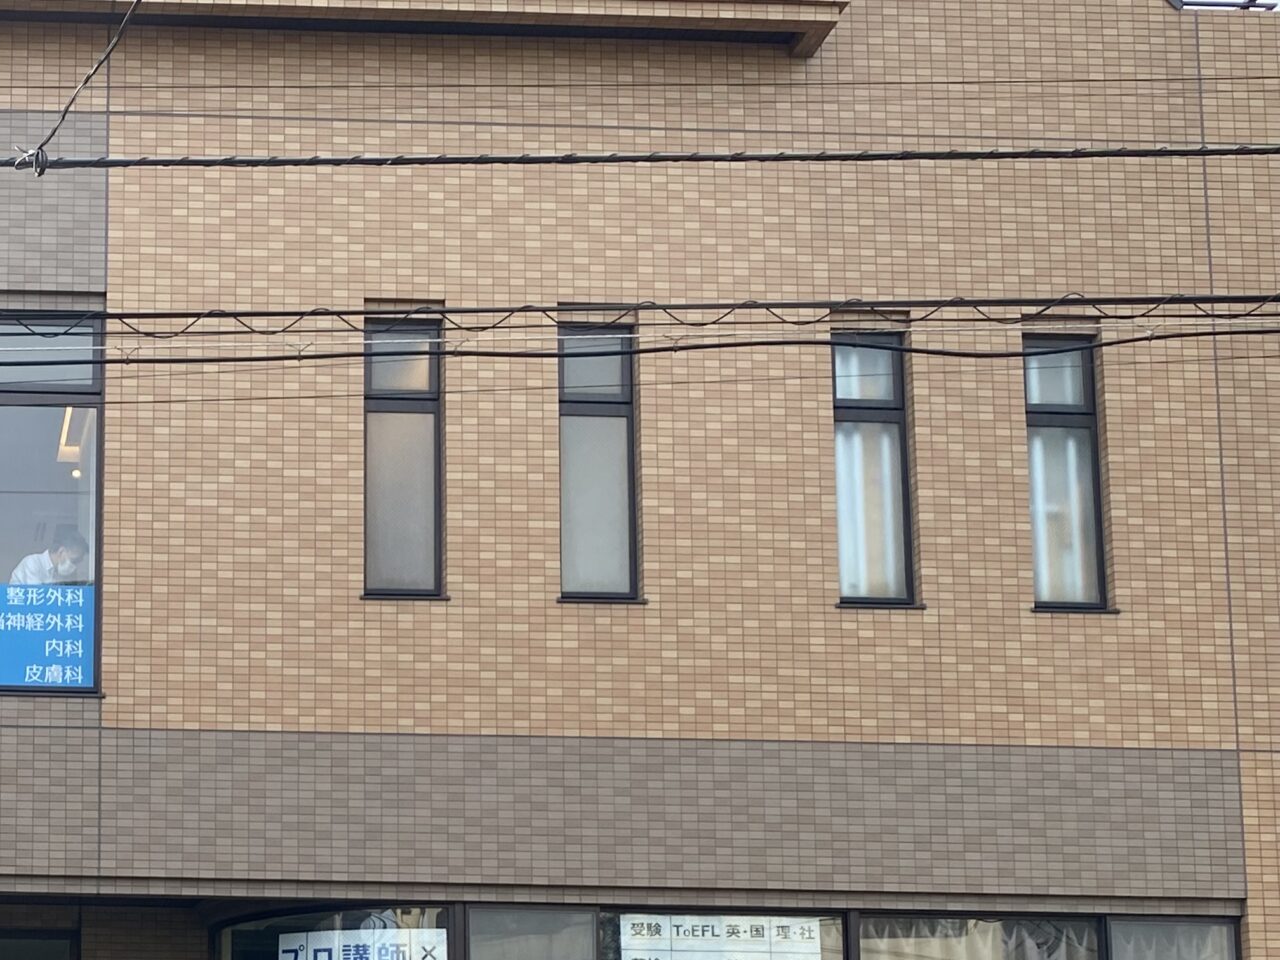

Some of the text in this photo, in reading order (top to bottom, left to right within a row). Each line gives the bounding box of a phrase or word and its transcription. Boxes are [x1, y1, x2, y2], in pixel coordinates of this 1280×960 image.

[6, 587, 85, 606] 整形外科
[44, 639, 84, 659] 内科
[24, 664, 84, 684] 皮膚科
[630, 922, 663, 937] 受験
